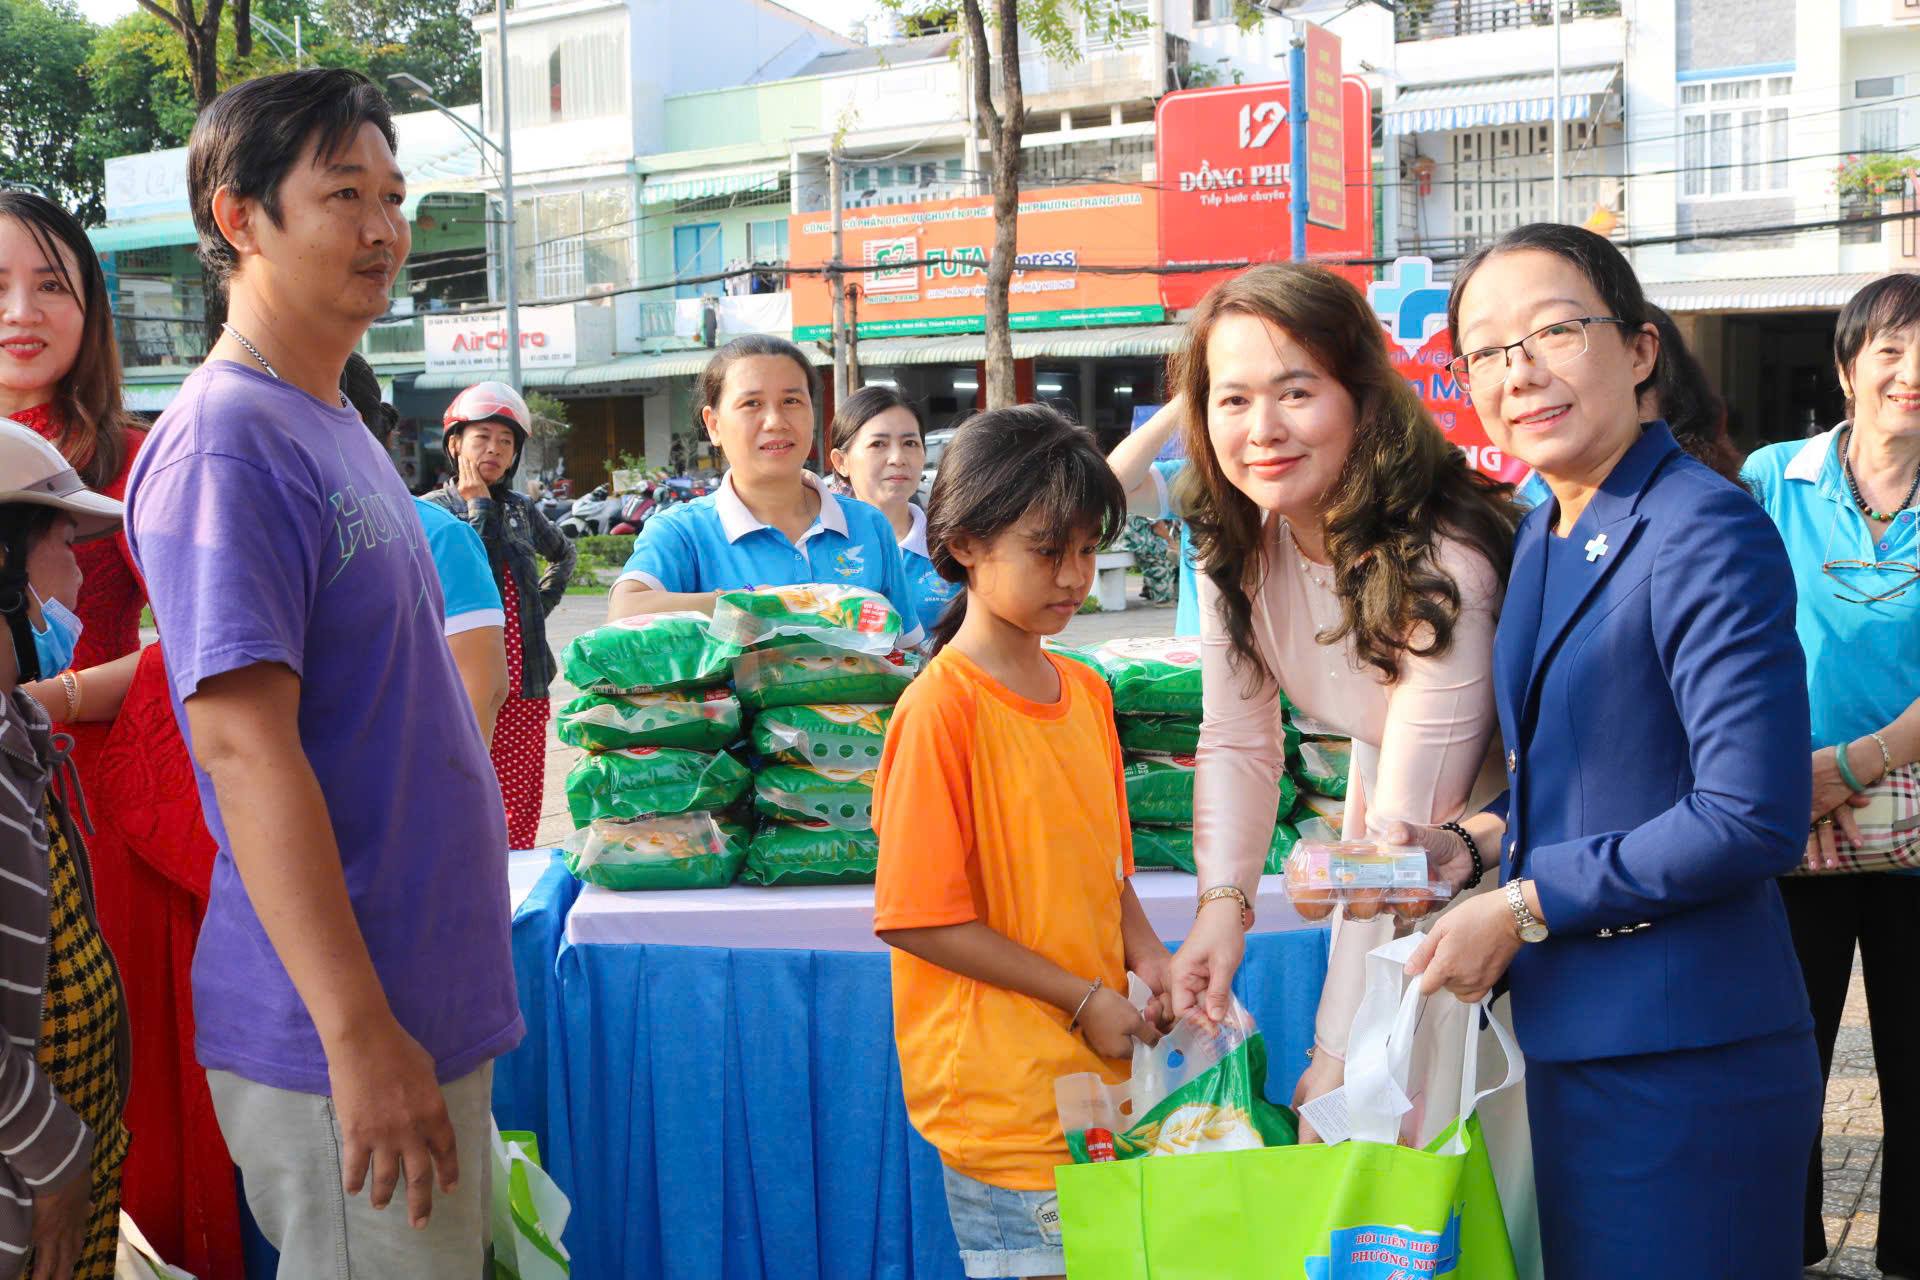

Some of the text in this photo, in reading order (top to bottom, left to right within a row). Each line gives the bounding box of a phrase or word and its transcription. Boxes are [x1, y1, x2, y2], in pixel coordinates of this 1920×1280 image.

[1179, 160, 1244, 192] ĐỒNG
[1079, 195, 1115, 209] TRANG
[1117, 193, 1142, 206] FUTA
[926, 247, 1075, 280] FUTA press
[452, 328, 545, 352] AirChro
[1356, 1232, 1377, 1245] HỘI
[1380, 1233, 1407, 1248] LIÊN
[1414, 1258, 1437, 1271] NIN
